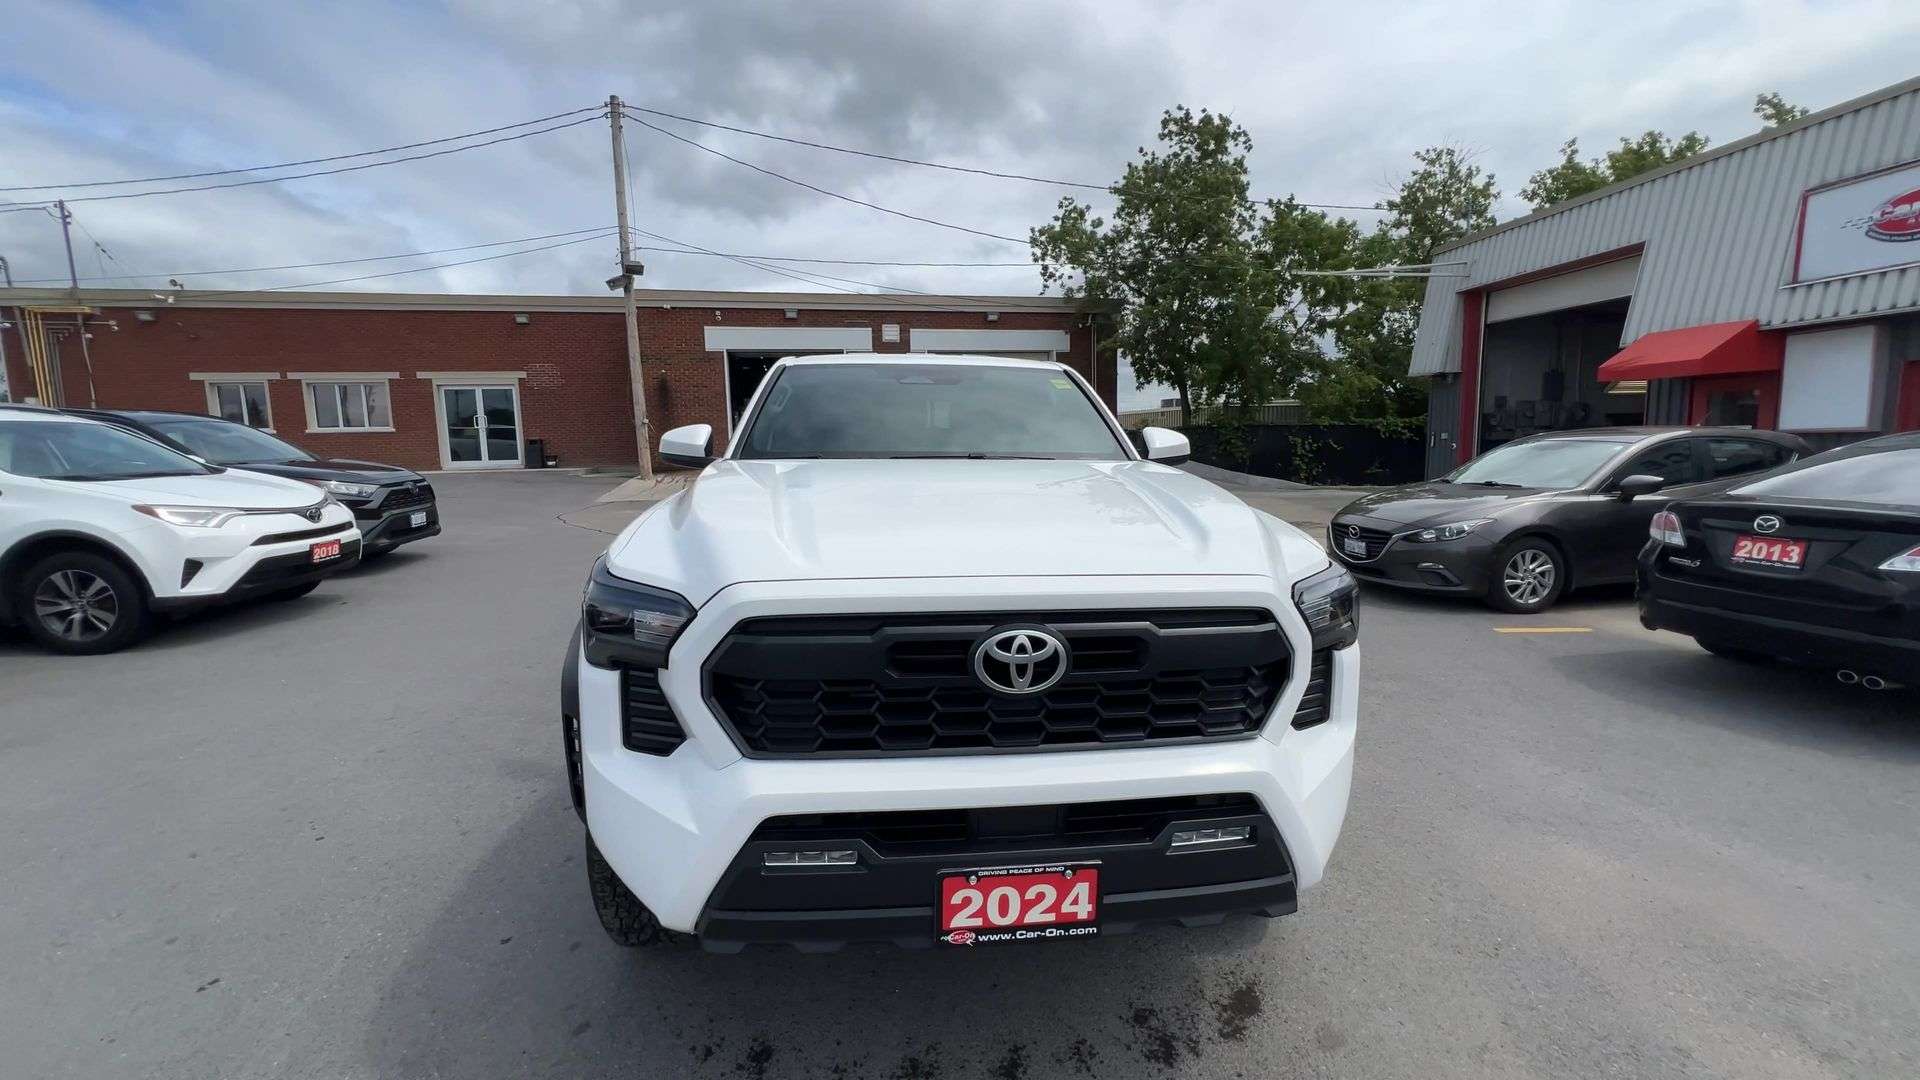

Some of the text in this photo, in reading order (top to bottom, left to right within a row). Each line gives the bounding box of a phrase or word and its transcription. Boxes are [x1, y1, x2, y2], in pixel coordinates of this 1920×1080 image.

[313, 544, 340, 560] 2018
[1737, 541, 1801, 564] 2013
[950, 882, 1093, 928] 2024
[978, 926, 1097, 942] www.Car-On.com
